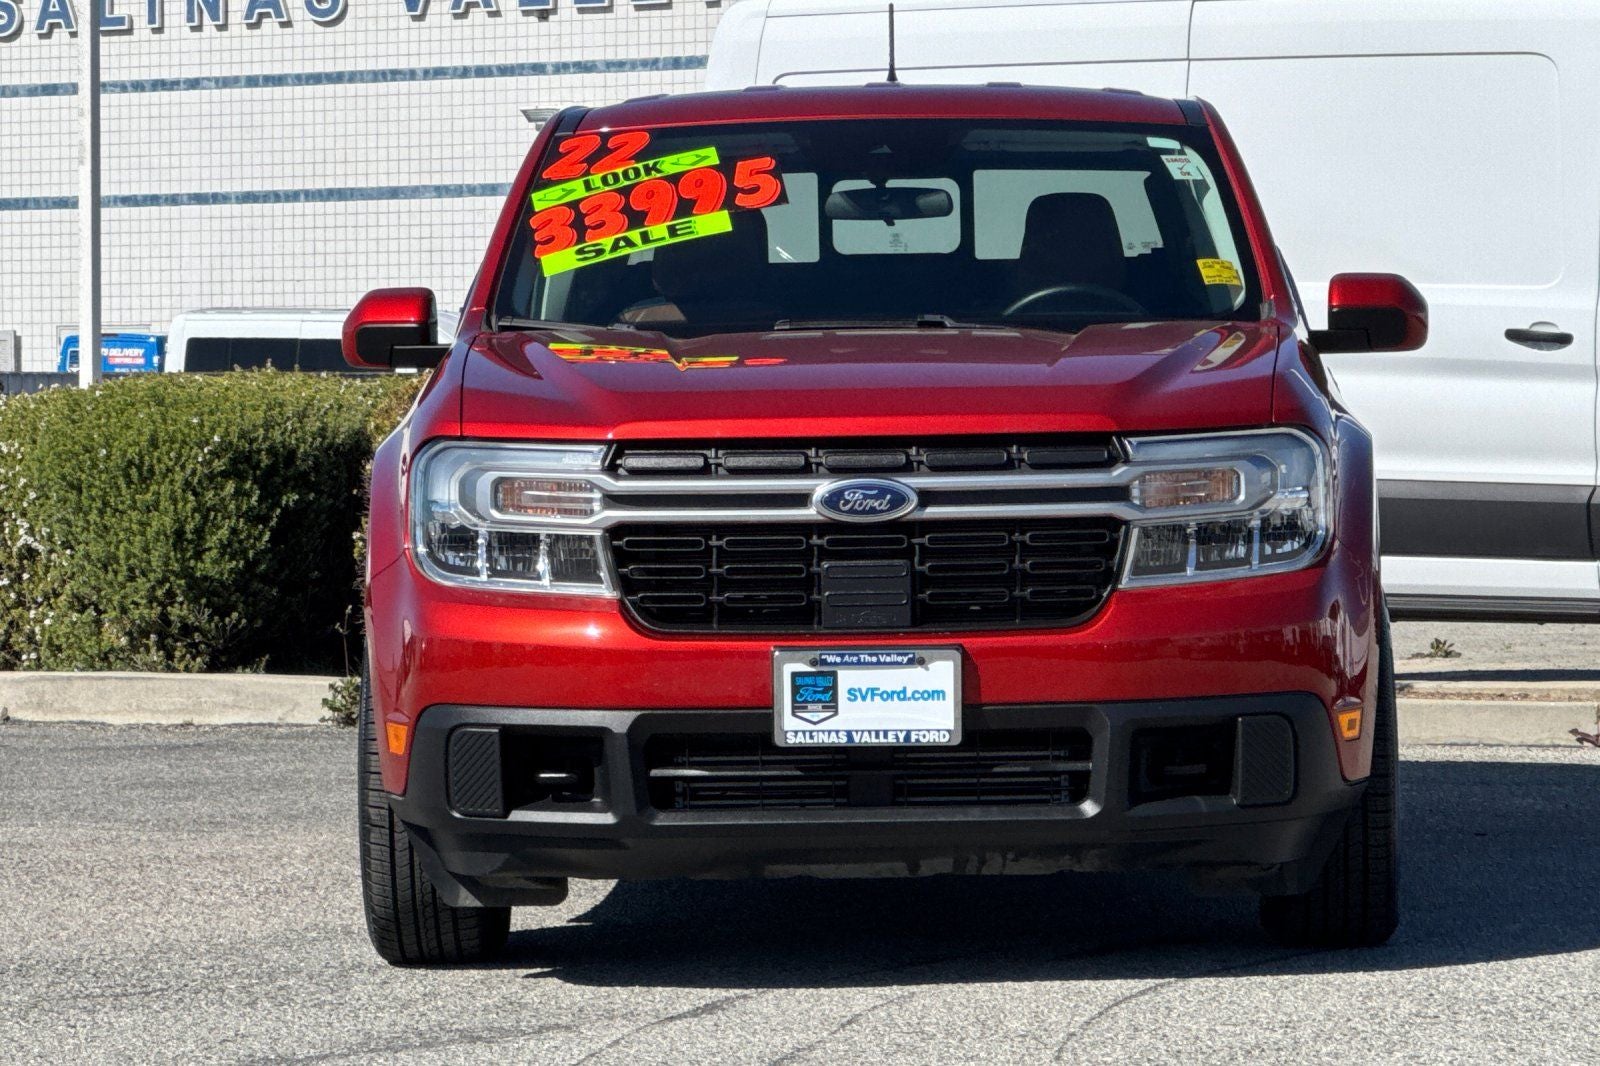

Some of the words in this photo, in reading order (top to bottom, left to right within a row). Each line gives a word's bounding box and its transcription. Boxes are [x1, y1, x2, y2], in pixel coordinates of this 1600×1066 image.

[542, 131, 650, 179] 22
[582, 160, 666, 193] LOOK
[529, 156, 783, 258] 33995
[574, 219, 696, 262] SALE
[109, 348, 145, 356] DELIVERY
[838, 488, 892, 511] Ford
[842, 654, 859, 663] Are
[860, 653, 877, 663] The
[796, 686, 833, 701] Ford
[847, 686, 946, 702] SVFord.com
[786, 731, 847, 743] SALINAS
[852, 730, 906, 743] VALLEY
[911, 730, 950, 742] FORD
